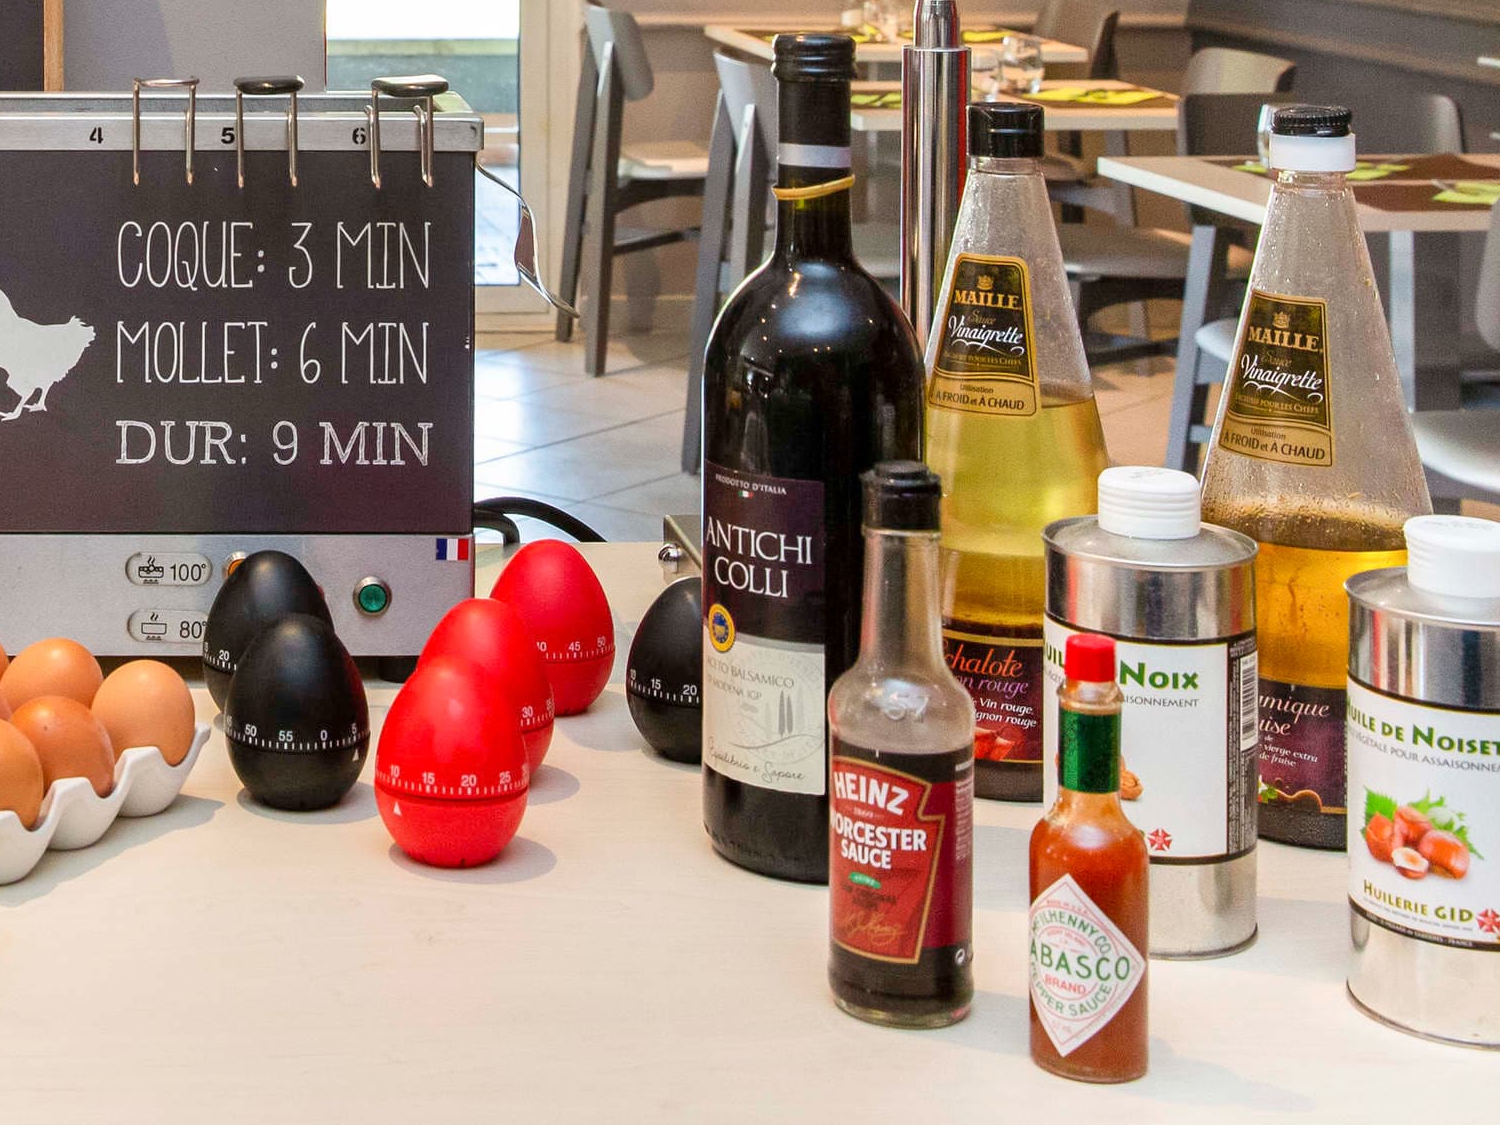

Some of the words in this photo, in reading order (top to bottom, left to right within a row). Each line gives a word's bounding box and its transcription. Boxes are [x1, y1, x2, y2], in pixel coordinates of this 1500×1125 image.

[88, 127, 104, 144] 4
[220, 126, 236, 145] 5
[351, 126, 368, 145] 6
[117, 221, 265, 291] COQUE:
[288, 222, 313, 289] 3
[337, 221, 432, 289] MIN
[953, 289, 1022, 311] MAILLE
[948, 315, 1024, 349] Vinaigrette
[1248, 326, 1320, 353] MAILLE
[117, 321, 278, 384] MOLLET:
[300, 321, 322, 384] 6
[341, 321, 429, 384] MIN
[1241, 354, 1323, 393] Vinaigrette
[942, 391, 969, 404] FROID
[970, 398, 978, 406] et
[987, 397, 1025, 411] CHAUD
[116, 420, 247, 466] DUR:
[272, 420, 298, 465] 9
[319, 421, 434, 466] MIN
[1230, 433, 1260, 451] FROID
[1260, 442, 1269, 452] et
[1280, 442, 1326, 461] CHAUD
[715, 473, 750, 490] PRODOTTO
[752, 482, 787, 496] D'ITALIA
[706, 515, 813, 565] ANTICHI
[169, 563, 207, 582] 100°
[714, 556, 789, 599] COLLI
[218, 649, 230, 662] 20
[568, 641, 581, 652] 45
[651, 678, 662, 690] 15
[682, 684, 698, 696] 20
[730, 665, 795, 689] BALSAMICO
[977, 678, 1029, 700] rouge
[522, 706, 533, 719] 30
[979, 697, 997, 709] Vin
[1259, 695, 1331, 724] mique
[244, 724, 258, 737] 50
[278, 730, 293, 743] 55
[320, 729, 328, 742] 0
[1005, 714, 1037, 730] rouge
[1381, 720, 1405, 743] DE
[1264, 743, 1292, 757] vierge
[1293, 750, 1319, 763] extra
[1270, 753, 1298, 767] fraise
[1390, 746, 1419, 763] POUR
[389, 765, 400, 779] 10
[422, 772, 436, 786] 15
[460, 774, 477, 788] 20
[499, 771, 511, 785] 25
[833, 771, 909, 815] HEINZ
[840, 838, 893, 870] SAUCE
[1434, 905, 1474, 923] GID
[1030, 937, 1131, 981] ABASCO
[1044, 973, 1087, 995] BRAND
[1068, 984, 1112, 1018] SAUCE
